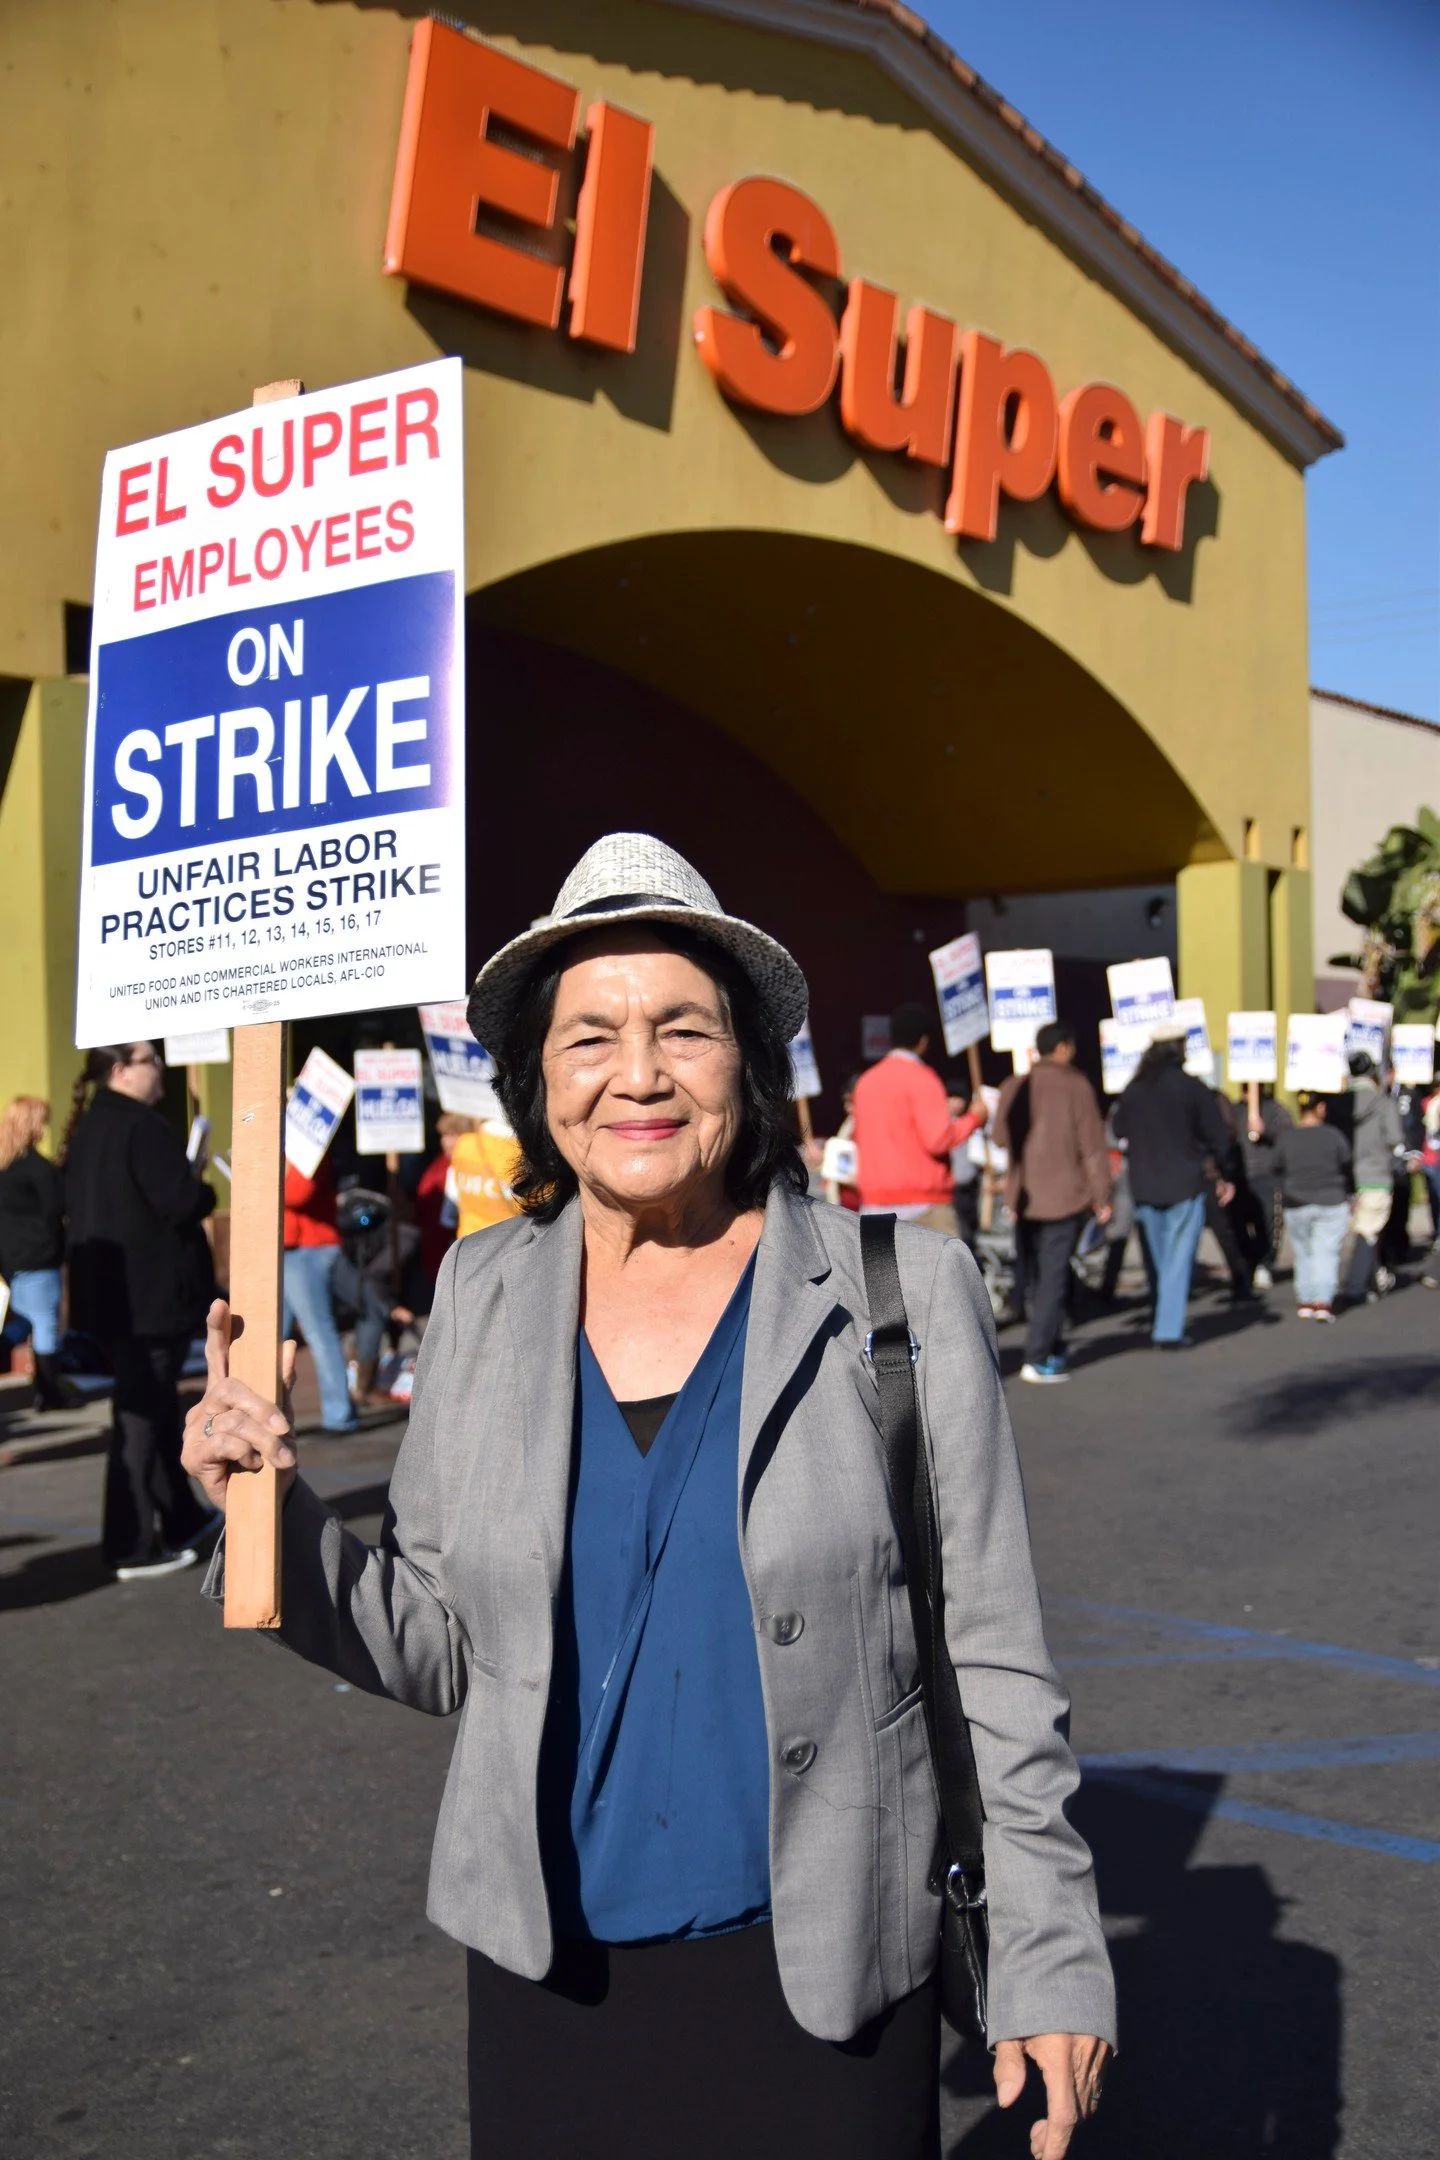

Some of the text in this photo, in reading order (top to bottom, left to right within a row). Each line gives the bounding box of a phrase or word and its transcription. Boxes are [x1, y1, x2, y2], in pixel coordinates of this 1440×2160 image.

[384, 15, 1209, 552] El Super
[115, 387, 440, 538] EL SUPER
[133, 499, 415, 612] EMPLOYEES
[227, 618, 304, 687] ON
[111, 675, 431, 840] STRIKE
[138, 829, 397, 899] UNFAIR LABOR
[101, 863, 441, 944] PRACTICES STRIKE
[149, 909, 382, 960] STORES #11, 12, 13, 14, 15, 16, 17
[109, 942, 429, 998] UNITED FOOD AND COMMERCIAL WORKERS INTERNATIONAL
[145, 964, 386, 1011] UNION AND ITS CHARTERED LOCALS, AFL-CIO
